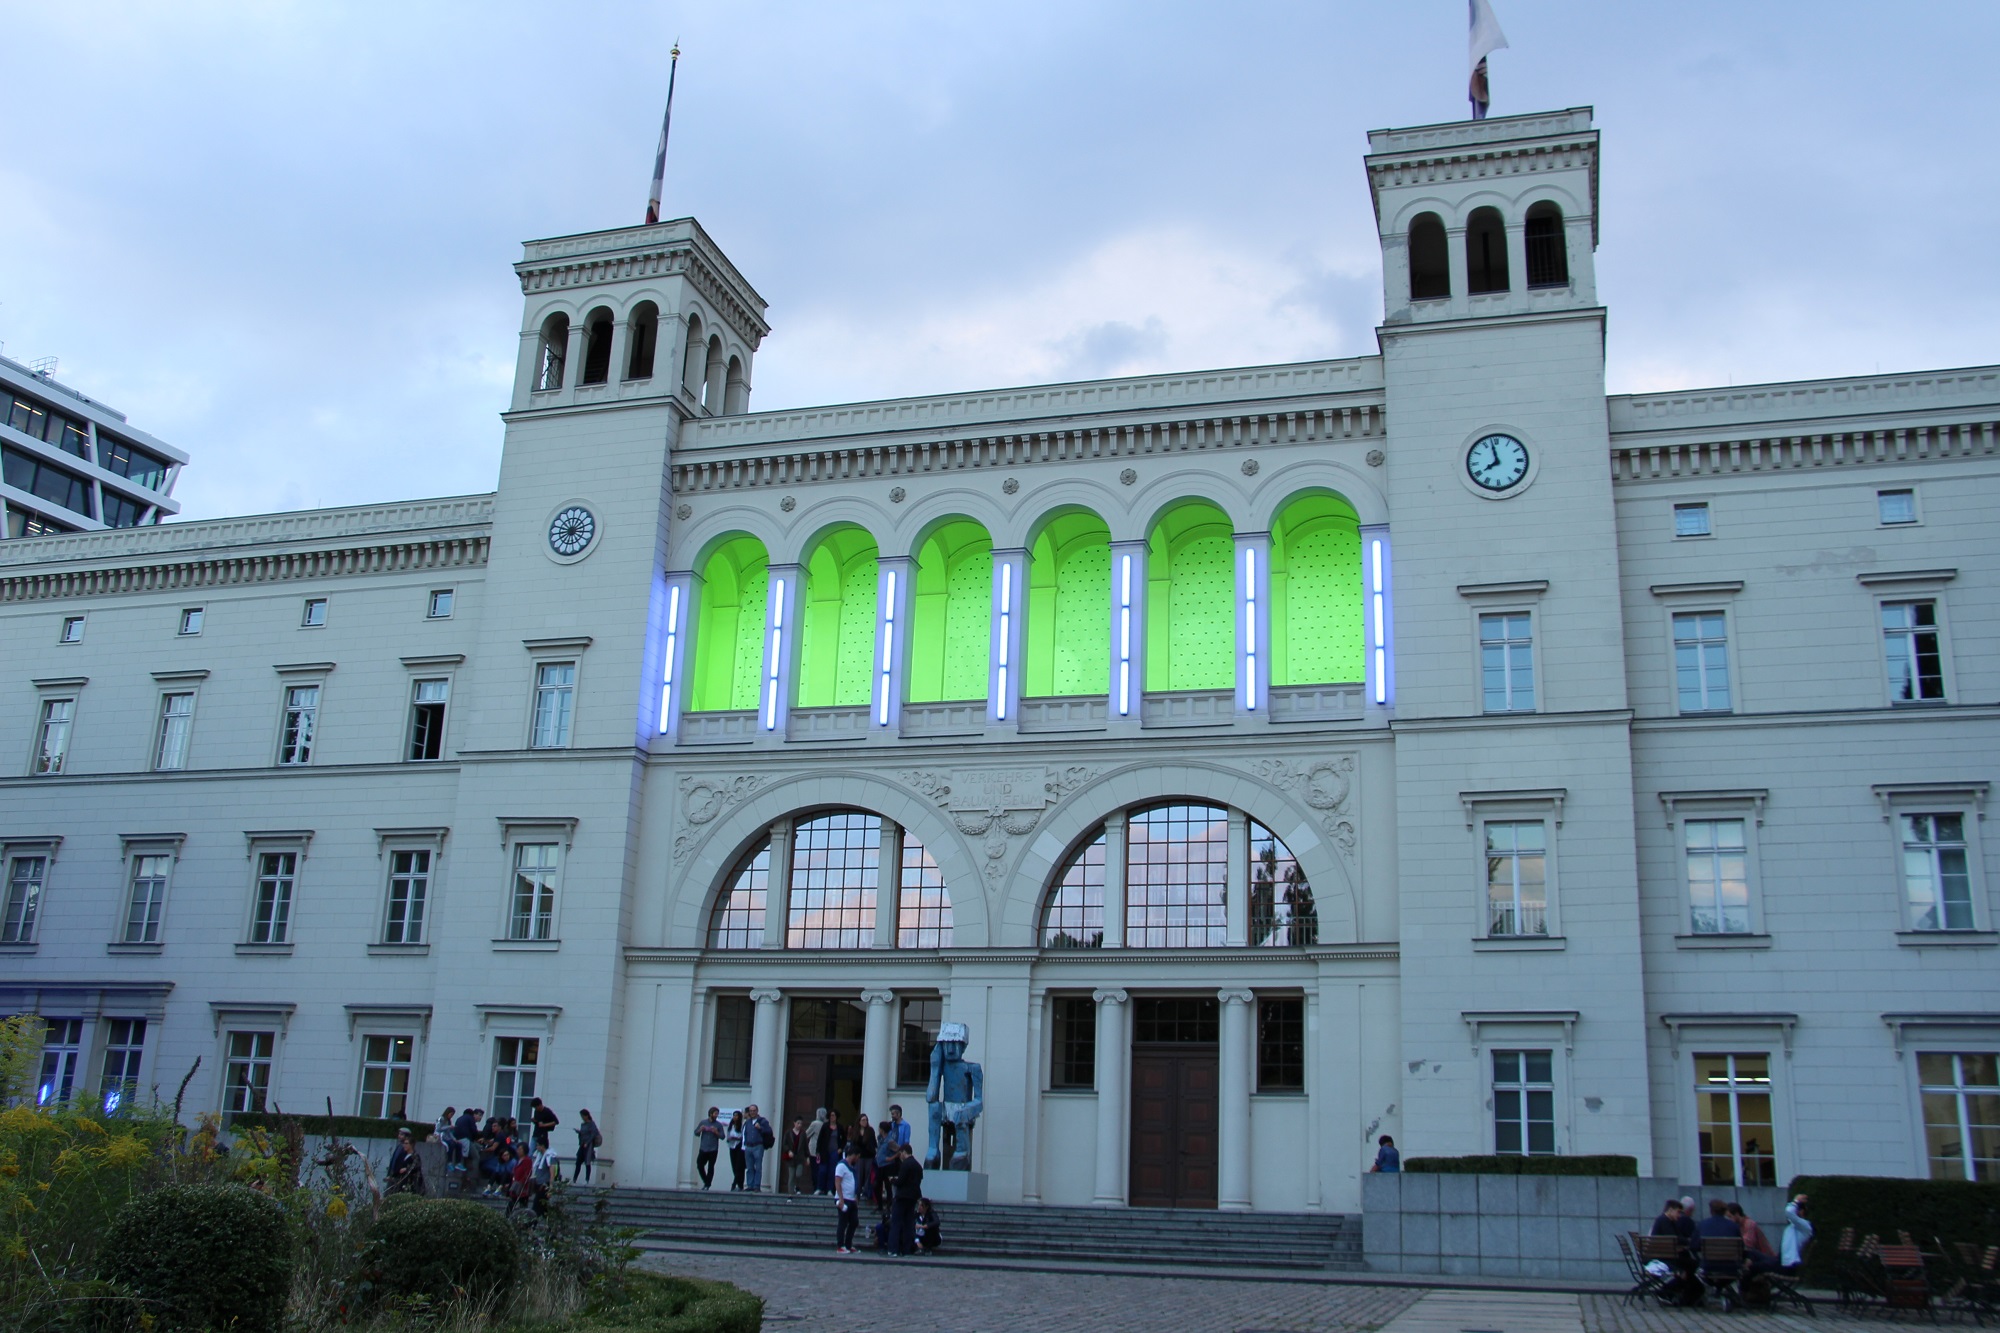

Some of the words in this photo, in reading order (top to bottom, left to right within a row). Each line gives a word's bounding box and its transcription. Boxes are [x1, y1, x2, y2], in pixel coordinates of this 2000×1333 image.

[961, 771, 1037, 784] VERKEHRS-
[983, 784, 1012, 795] UND
[953, 794, 1043, 807] BAUMUSEUM
